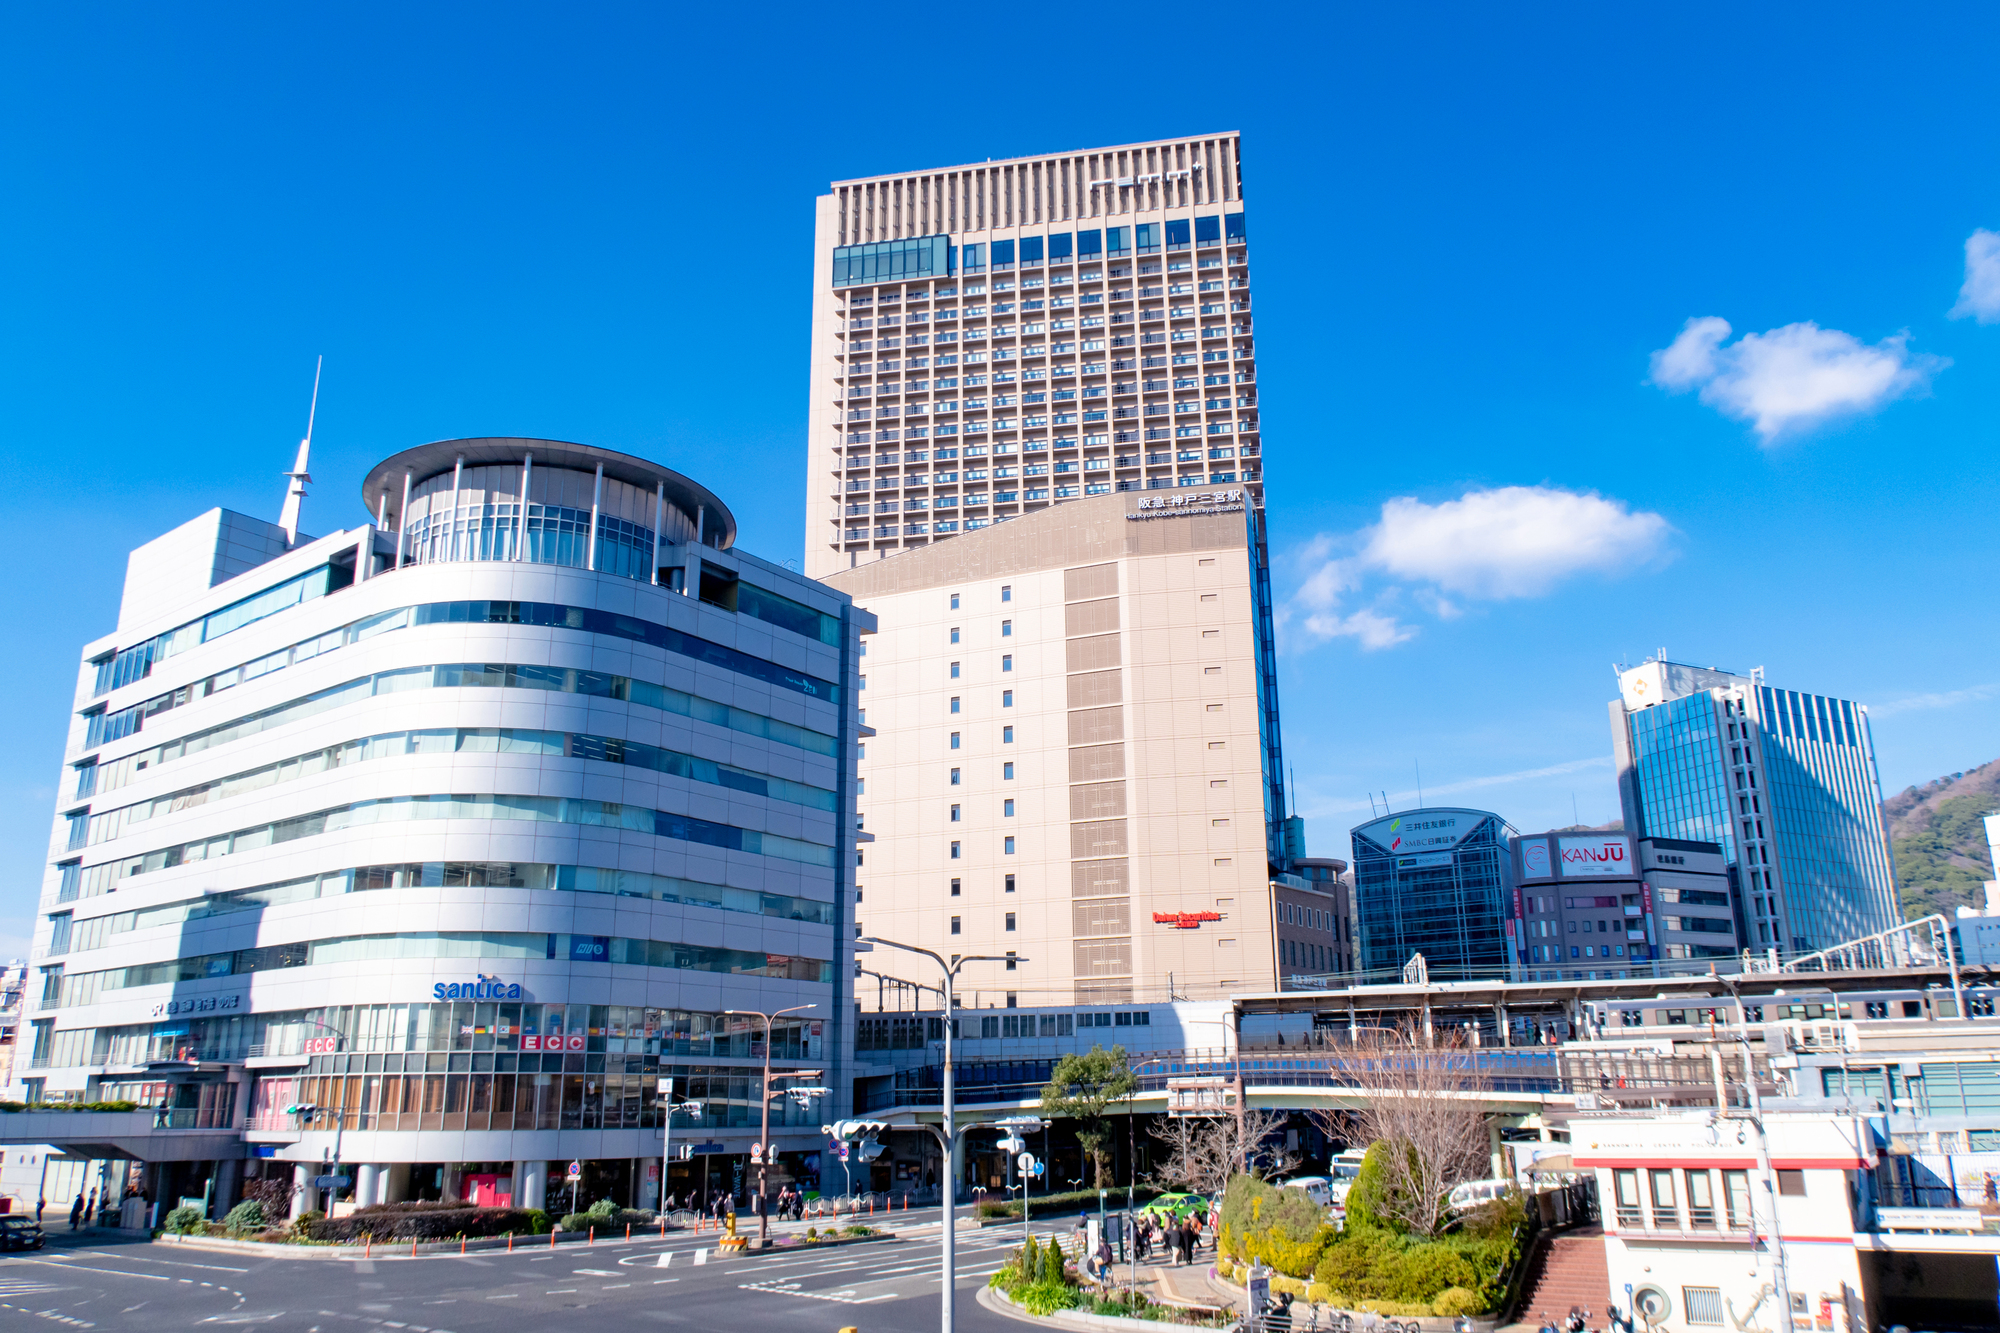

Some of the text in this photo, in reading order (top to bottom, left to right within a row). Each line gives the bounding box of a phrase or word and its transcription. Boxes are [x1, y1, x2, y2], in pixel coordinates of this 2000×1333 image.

[1138, 489, 1241, 509] 阪急 神戸三宮駅
[1215, 504, 1242, 512] Station
[1405, 818, 1456, 832] 三井住友銀行
[1152, 910, 1221, 922] Daiwa Securities
[433, 975, 521, 1000] santica
[305, 1037, 335, 1053] ECC
[525, 1036, 583, 1050] ECC
